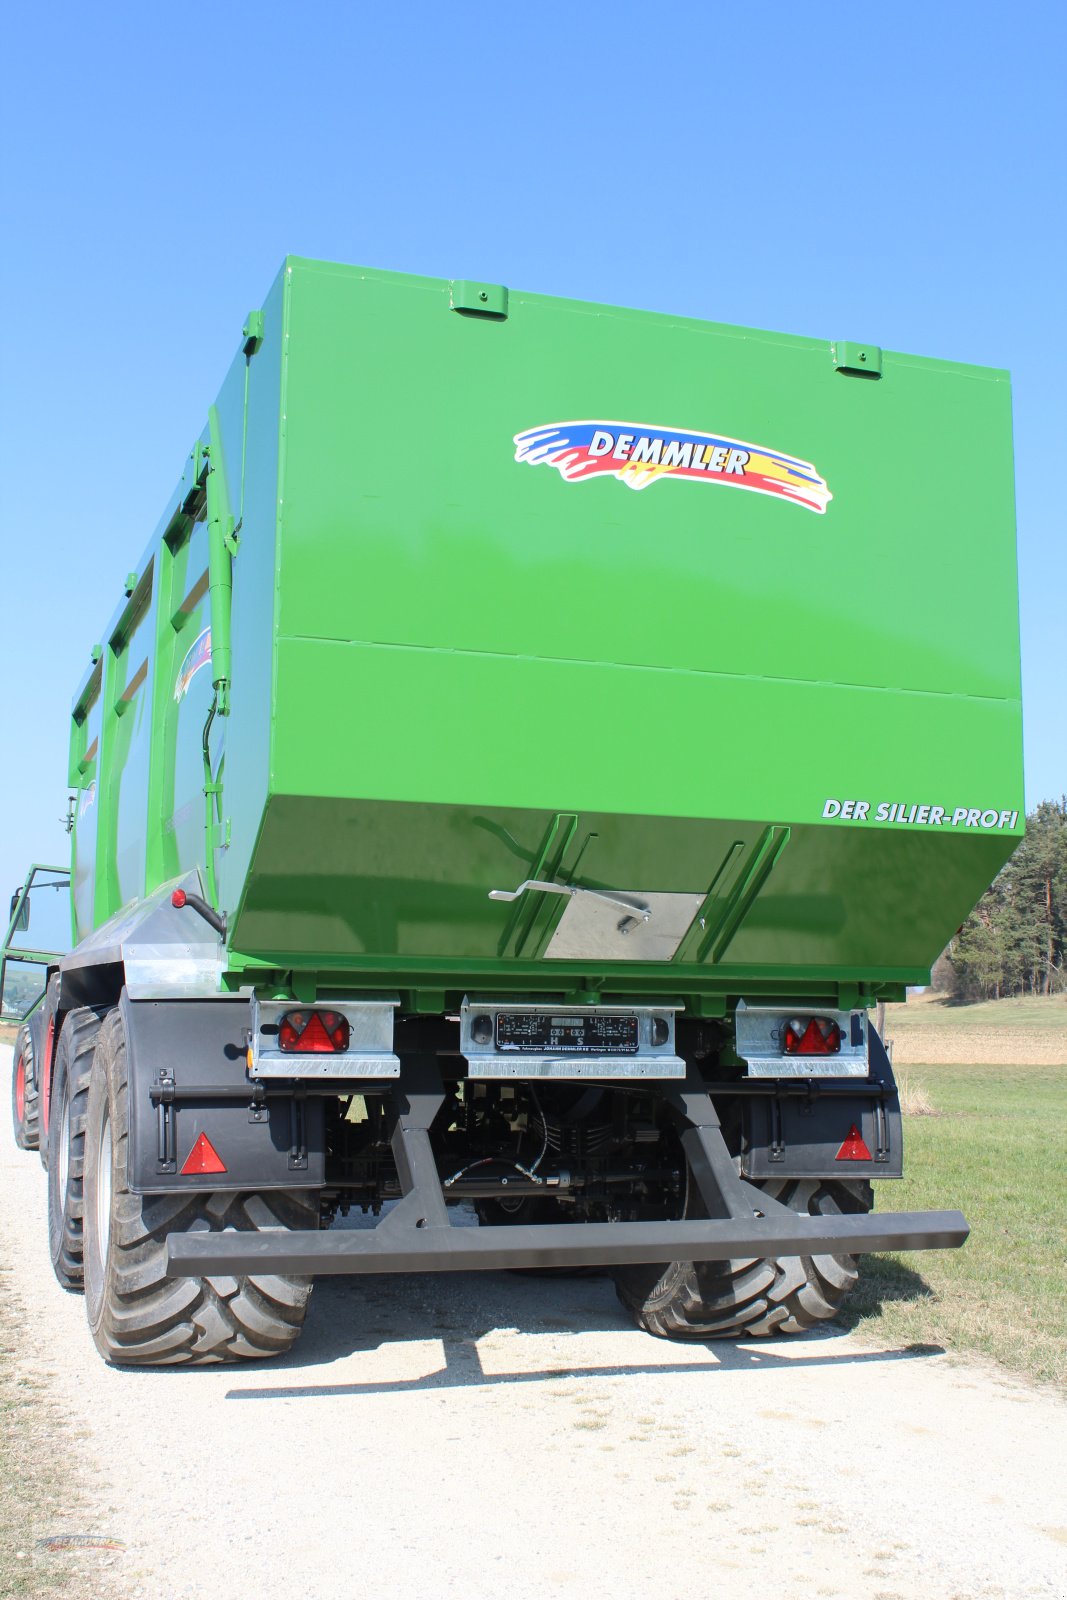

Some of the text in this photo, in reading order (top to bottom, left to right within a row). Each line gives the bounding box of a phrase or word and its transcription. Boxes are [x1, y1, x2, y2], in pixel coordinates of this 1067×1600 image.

[587, 430, 750, 476] DEMMLER
[822, 799, 1019, 829] DER SILIER-PROFI
